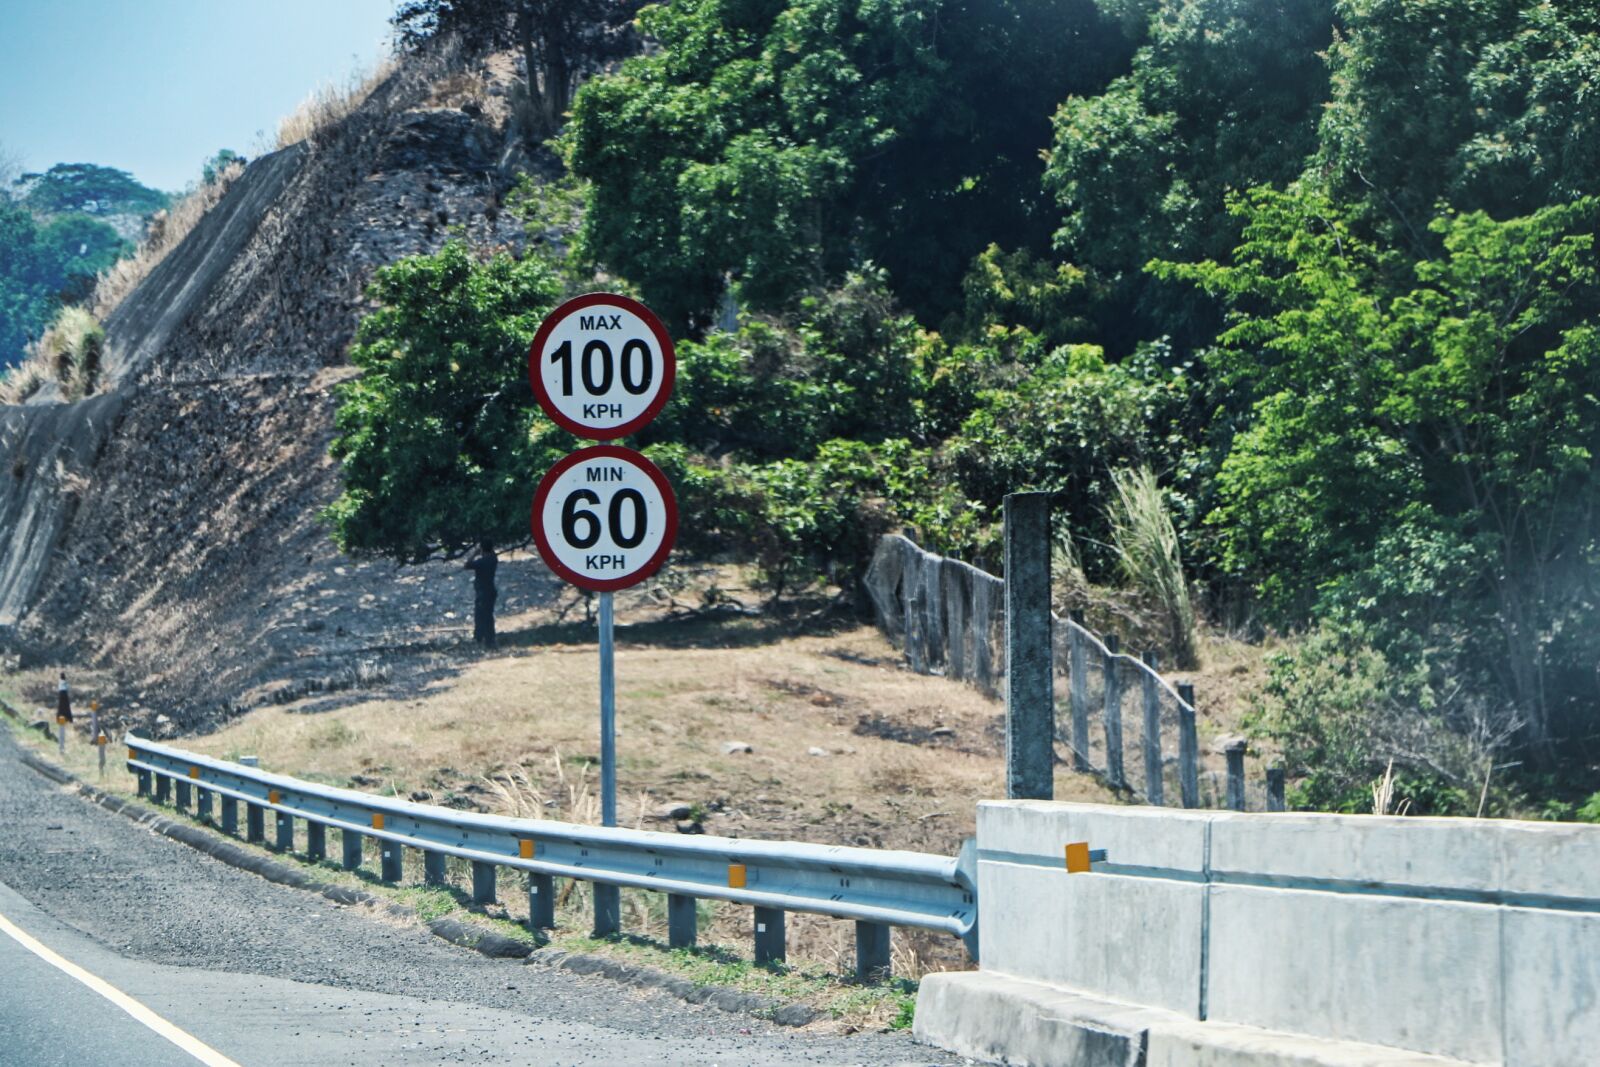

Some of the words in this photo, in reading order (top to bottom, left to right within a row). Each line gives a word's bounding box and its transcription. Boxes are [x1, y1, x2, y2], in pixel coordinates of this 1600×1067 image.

[580, 315, 622, 330] MAX
[550, 339, 653, 396] 100
[583, 404, 623, 418] KPH
[586, 467, 623, 481] MIN
[561, 488, 648, 549] 60
[585, 555, 625, 569] KPH
